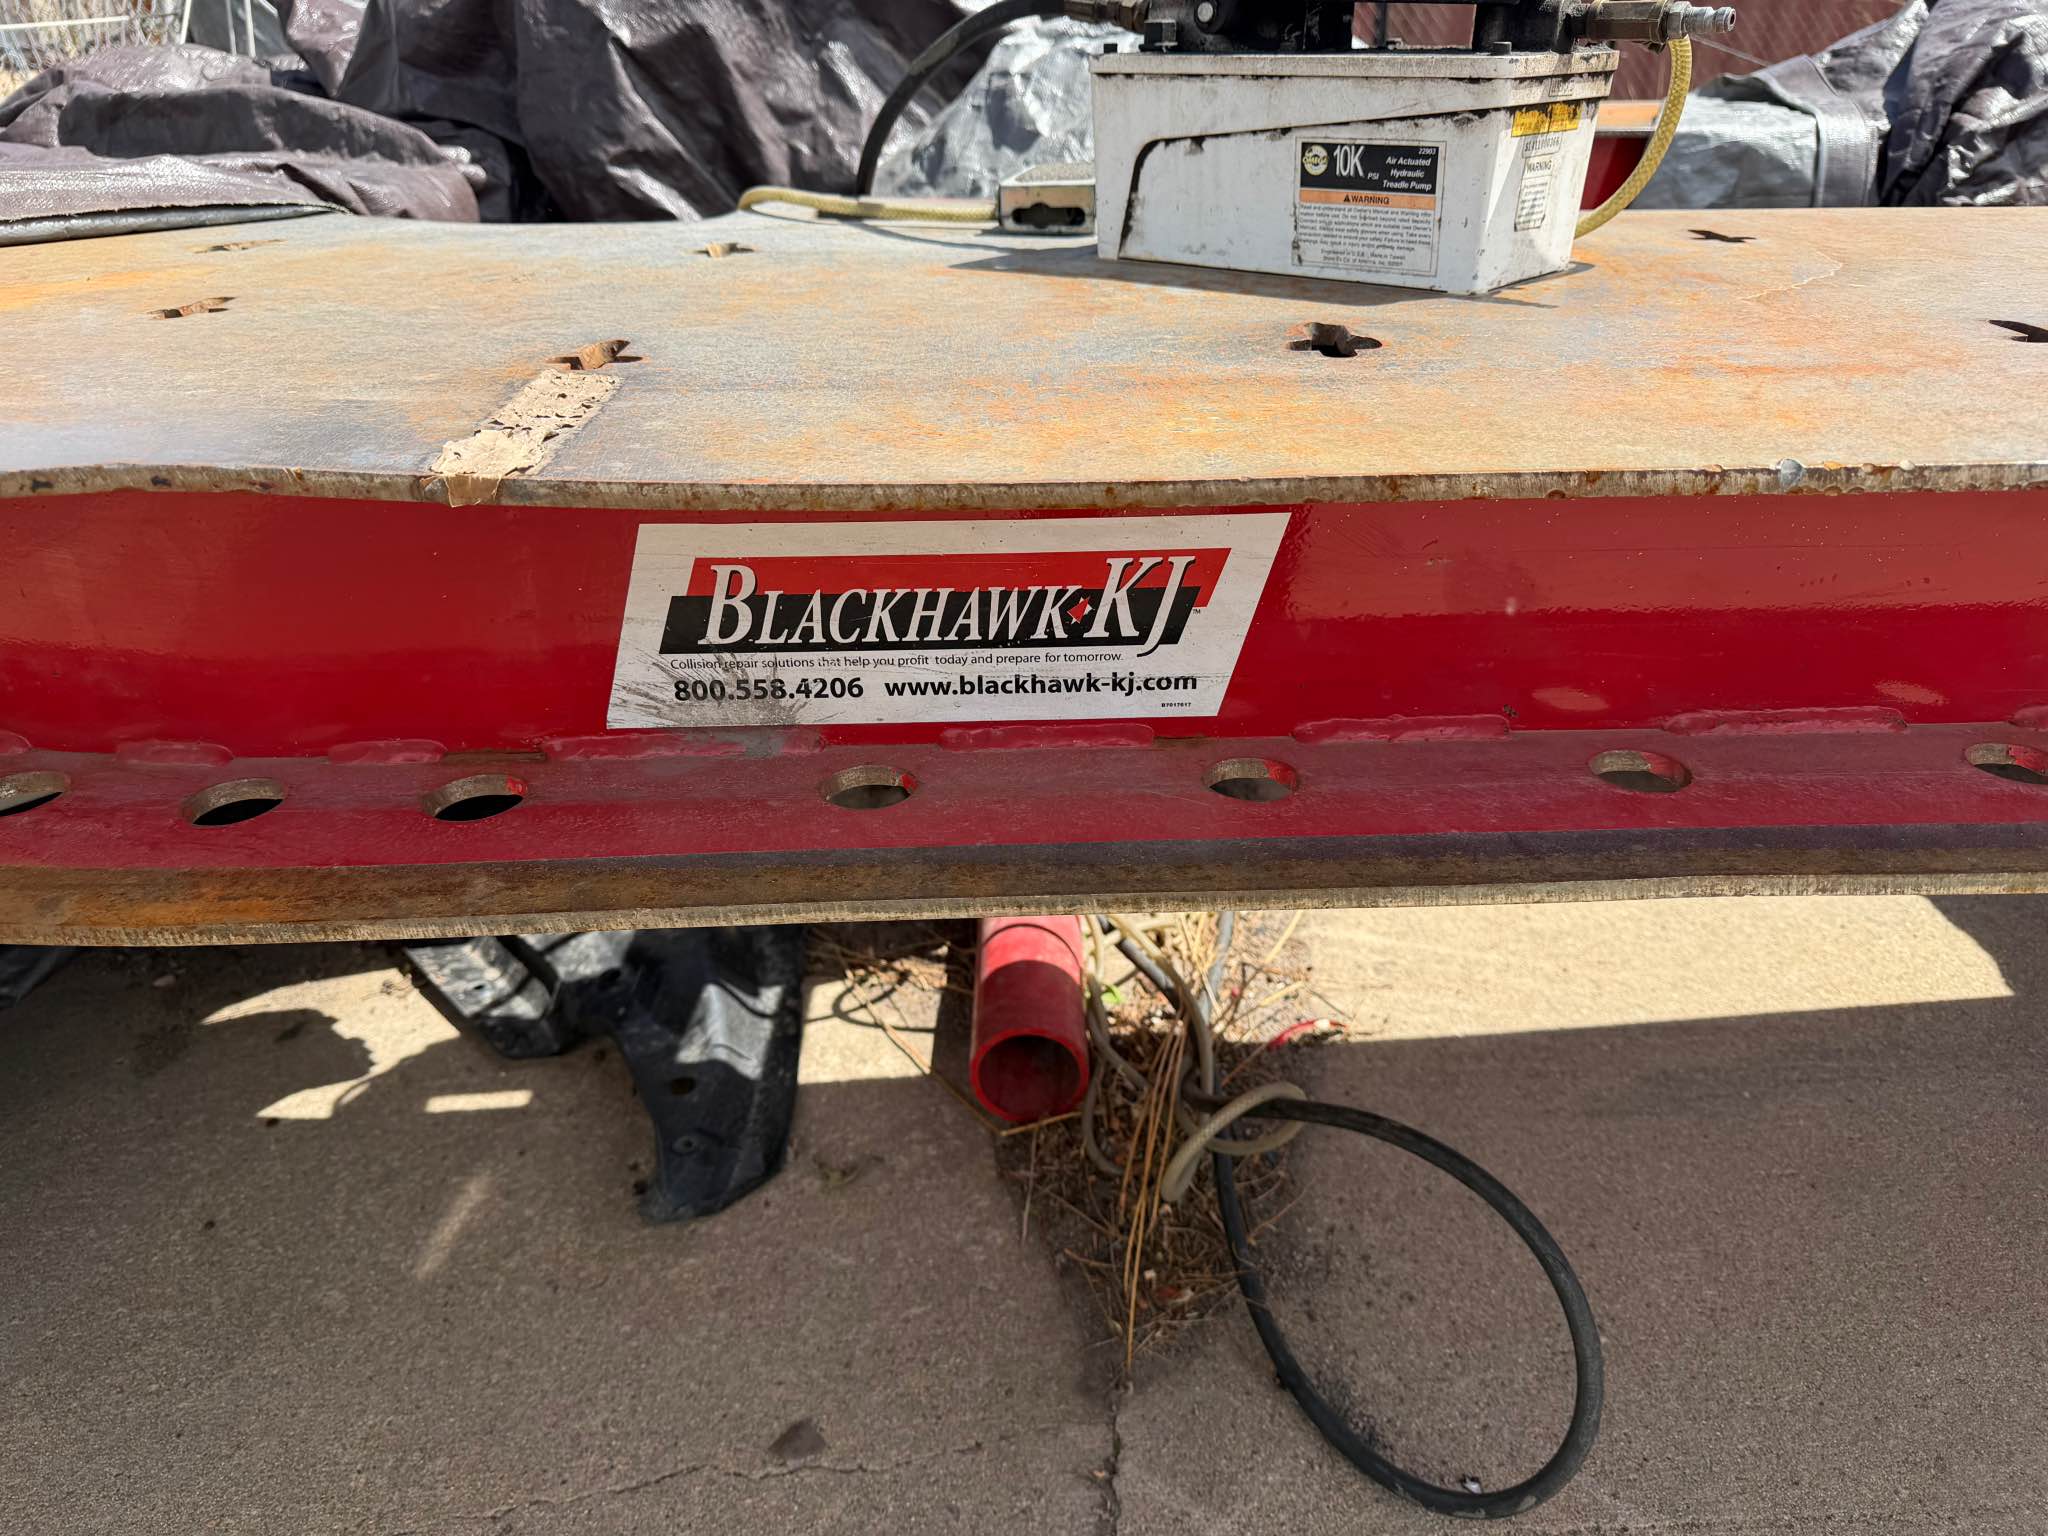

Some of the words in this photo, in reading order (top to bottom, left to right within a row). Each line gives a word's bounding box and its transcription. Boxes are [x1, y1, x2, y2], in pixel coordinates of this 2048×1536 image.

[1333, 145, 1365, 177] 10K
[1385, 156, 1397, 165] Air
[1398, 157, 1431, 166] Actuated
[1526, 160, 1552, 173] WARNING
[1367, 172, 1379, 180] PSI
[1391, 168, 1425, 178] Hydraulic
[1383, 180, 1409, 189] Treadle
[1410, 181, 1432, 191] Pump
[1351, 194, 1390, 205] WARNING
[697, 563, 1076, 648] BLACKHAWK
[1085, 554, 1195, 658] KJ
[671, 658, 722, 669] Collision
[724, 659, 759, 671] repair
[762, 657, 815, 668] solutions
[818, 656, 841, 667] that
[844, 655, 870, 670] help
[872, 658, 895, 669] you
[898, 654, 930, 668] profit
[935, 654, 969, 667] today
[971, 653, 993, 664] and
[996, 654, 1041, 667] prepare
[1044, 652, 1061, 663] for
[1064, 652, 1124, 663] tomorrow.
[674, 677, 864, 701] 800.558.4206
[885, 671, 1198, 697] www.blackhawk-kj.com
